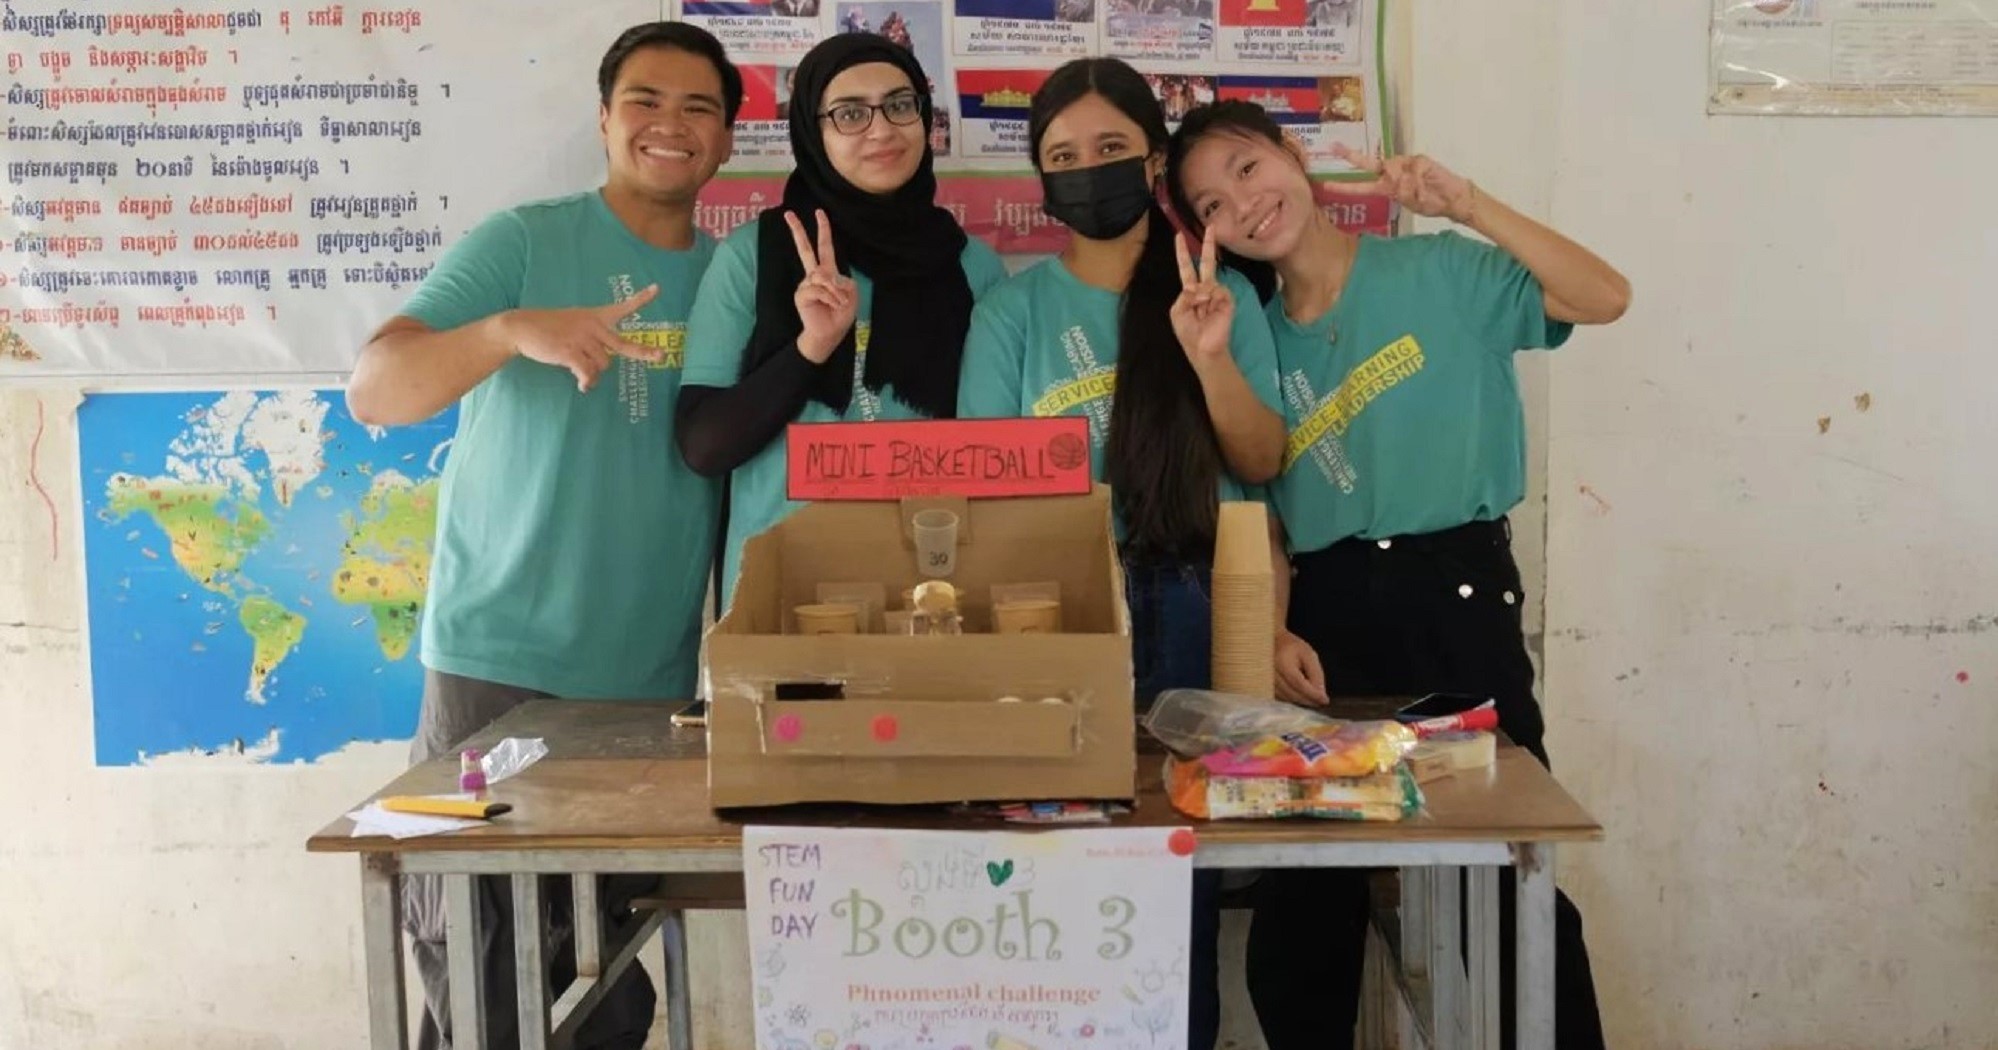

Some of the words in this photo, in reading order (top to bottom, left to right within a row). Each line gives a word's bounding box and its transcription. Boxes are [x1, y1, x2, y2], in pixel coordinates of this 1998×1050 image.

[806, 442, 876, 480] MINI
[887, 440, 1055, 482] BASKETBALL
[929, 551, 948, 565] 30
[758, 844, 821, 870] STEM
[769, 877, 815, 903] FUN
[771, 915, 818, 939] DAY
[831, 888, 1062, 961] Booth
[1097, 895, 1138, 961] 3
[847, 983, 981, 1002] Phnomenal
[987, 983, 1100, 1003] challenge
